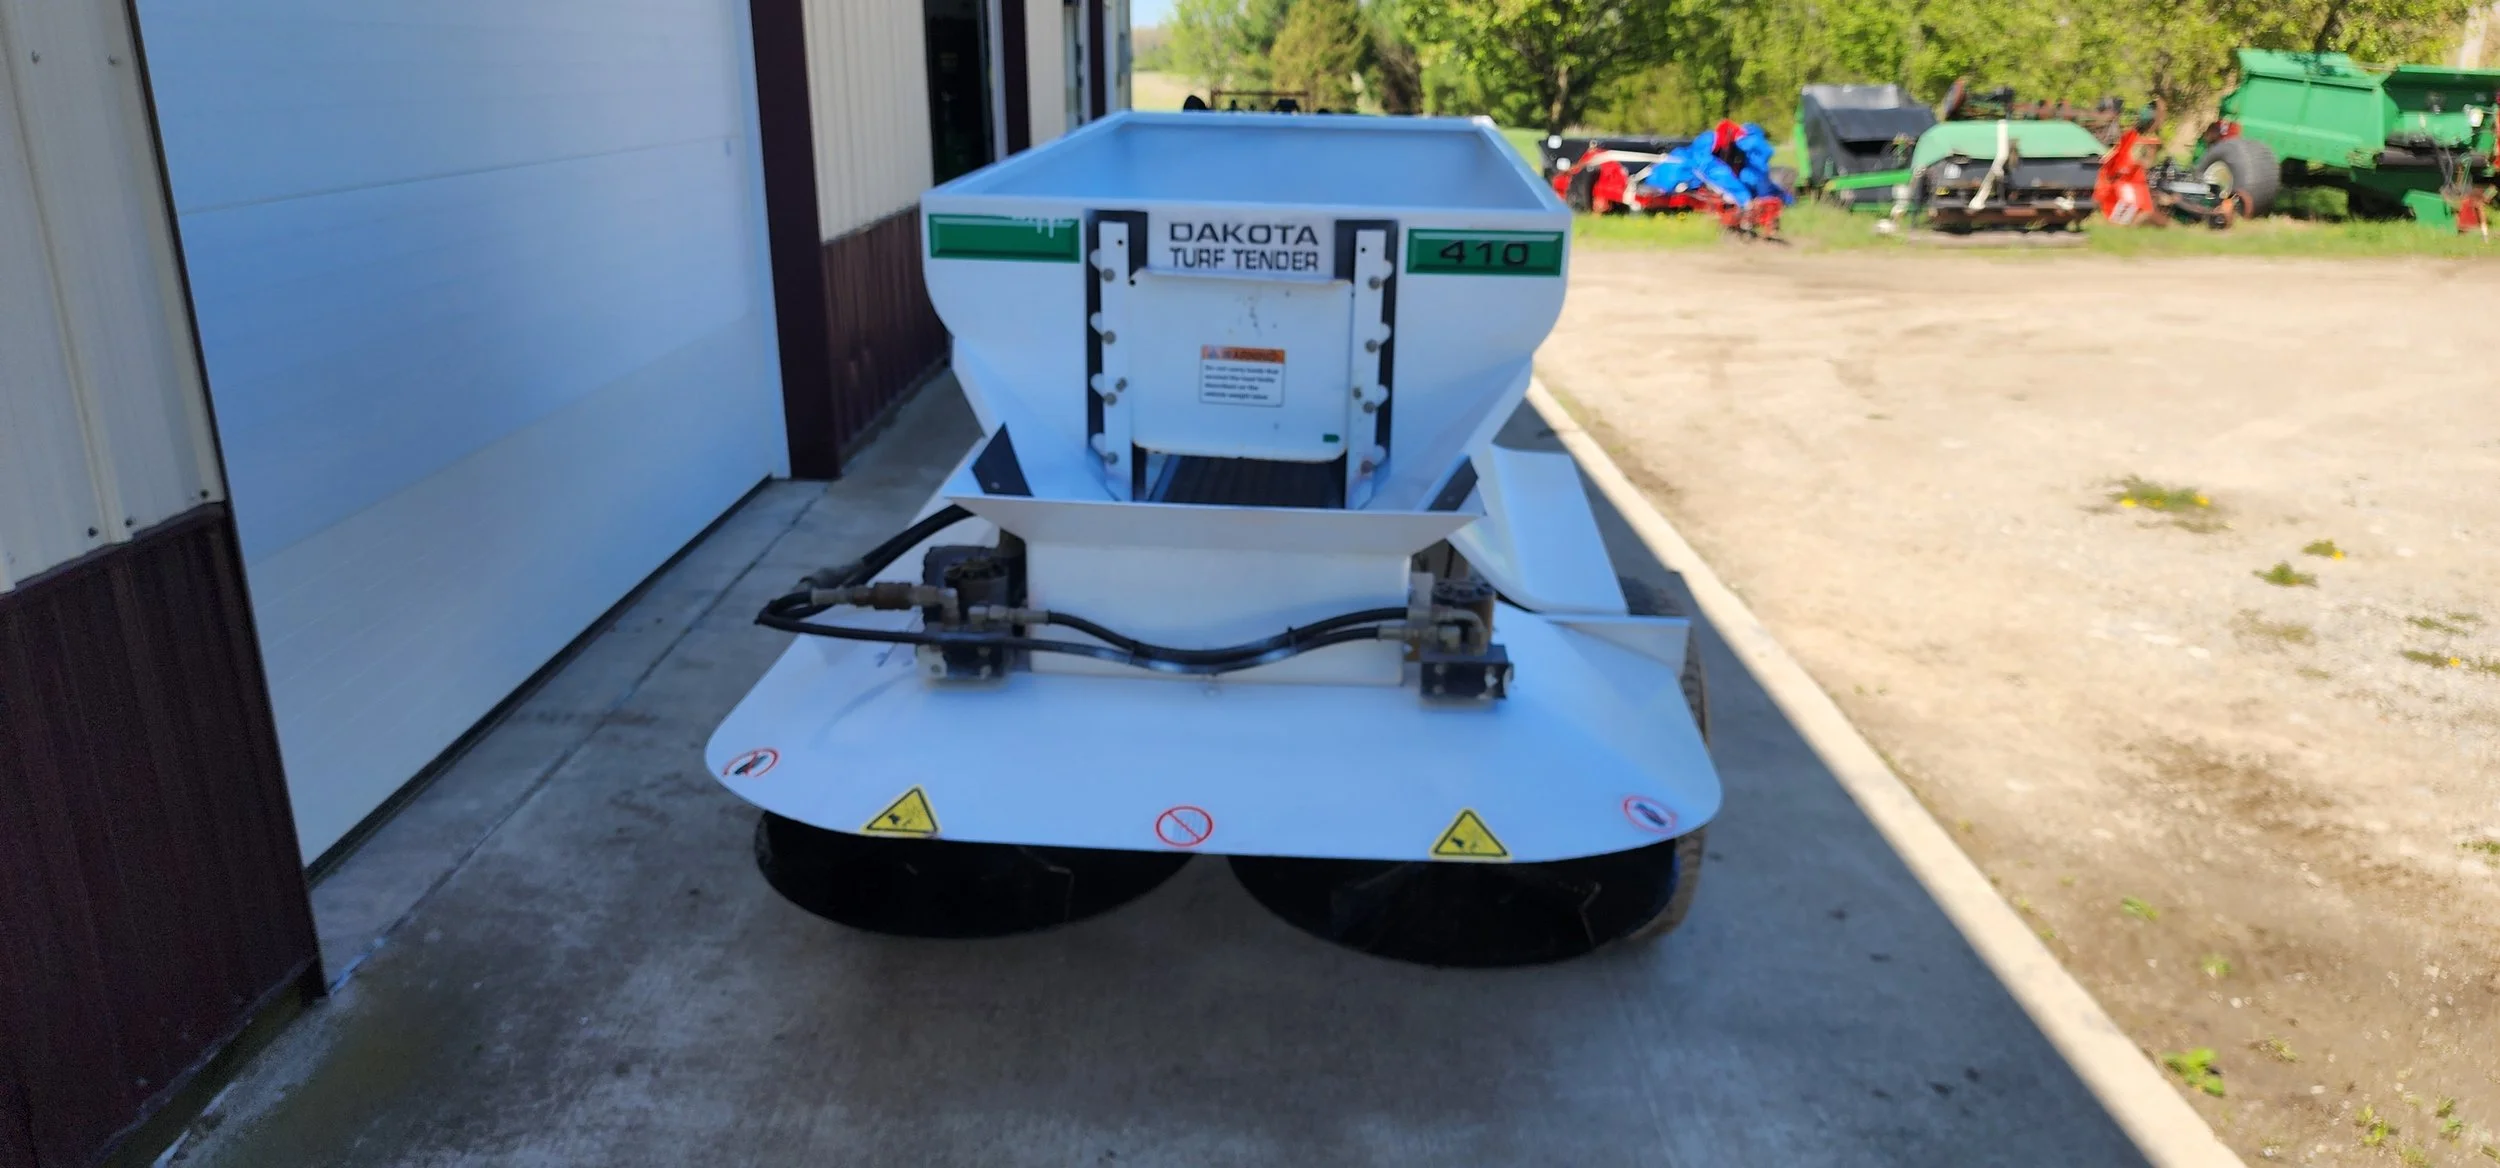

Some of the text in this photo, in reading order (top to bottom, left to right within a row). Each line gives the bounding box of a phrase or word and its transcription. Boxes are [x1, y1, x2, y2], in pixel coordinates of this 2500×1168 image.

[1169, 222, 1319, 246] DAKOTA
[1169, 247, 1319, 271] TURF TENDER
[1440, 239, 1530, 267] 410
